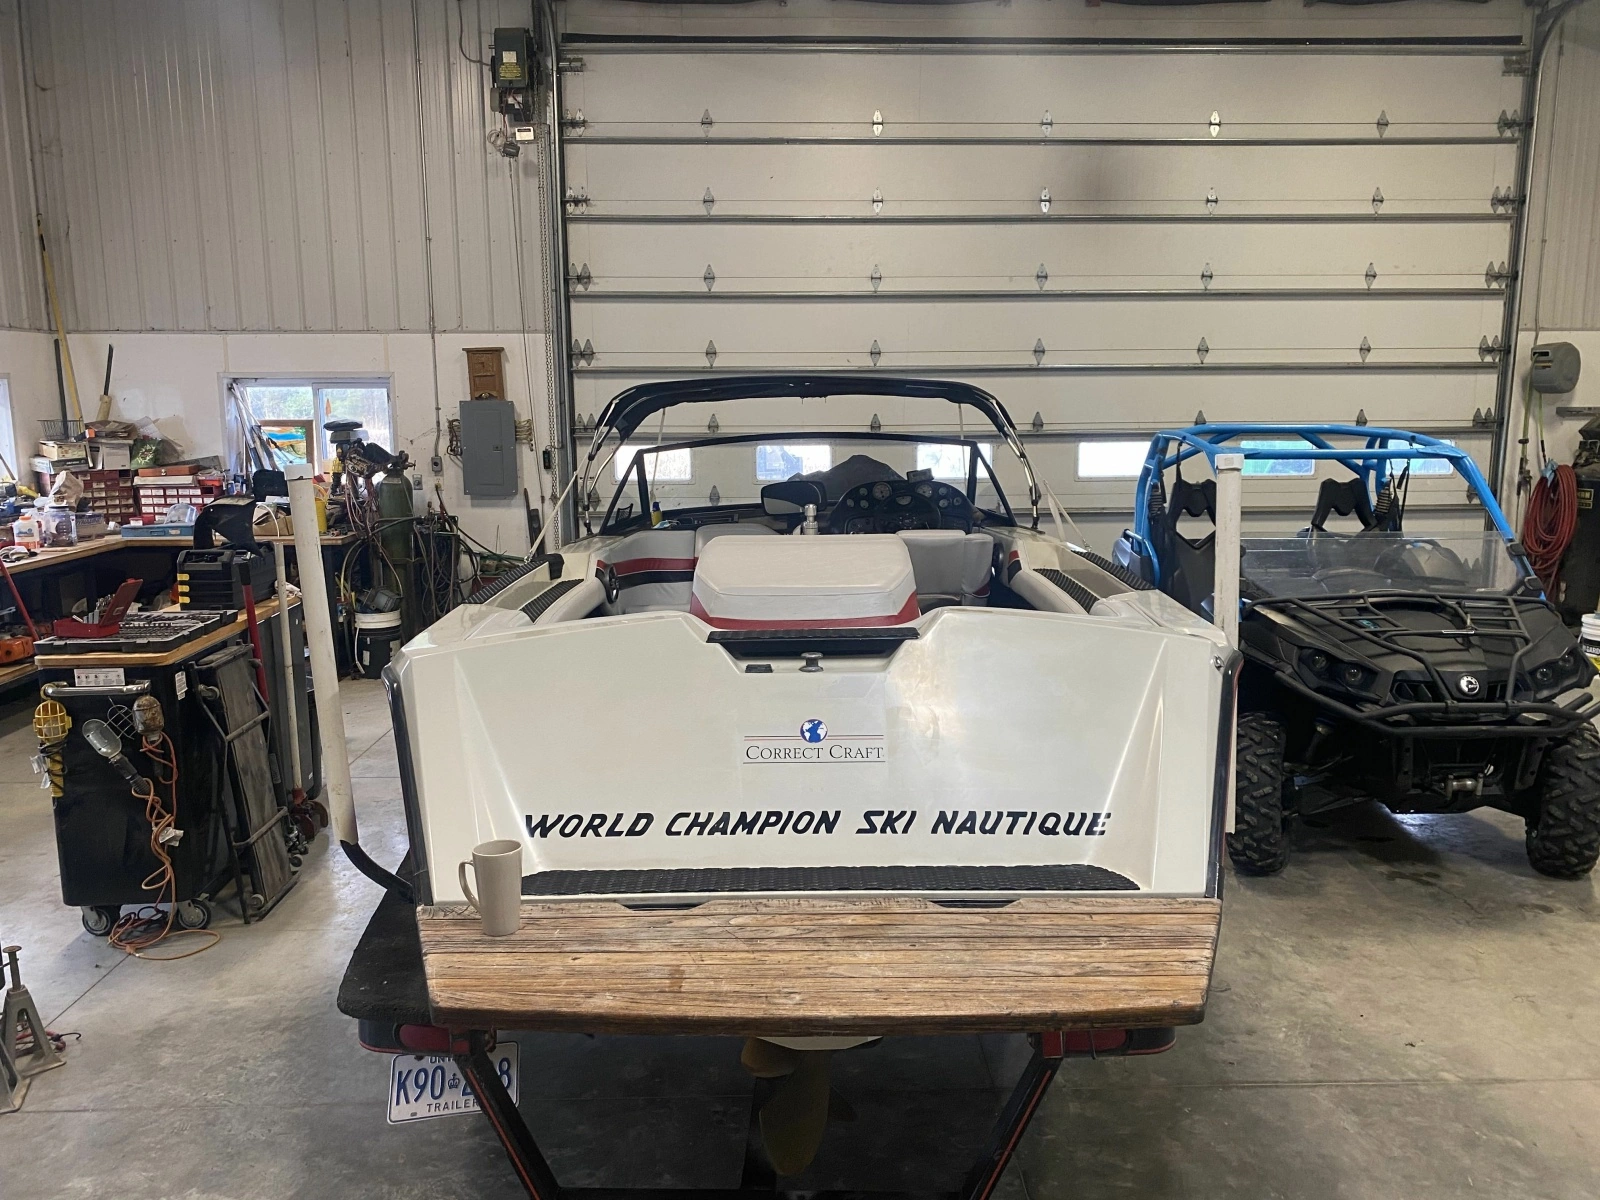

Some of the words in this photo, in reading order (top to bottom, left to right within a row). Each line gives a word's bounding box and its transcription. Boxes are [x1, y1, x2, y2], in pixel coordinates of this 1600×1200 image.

[746, 745, 824, 760] CORRECT
[829, 744, 884, 759] CRAFT
[525, 812, 654, 838] WORLD
[665, 810, 841, 836] CHAMPION
[855, 810, 917, 834] SKI
[930, 810, 1112, 836] NAUTIQUE
